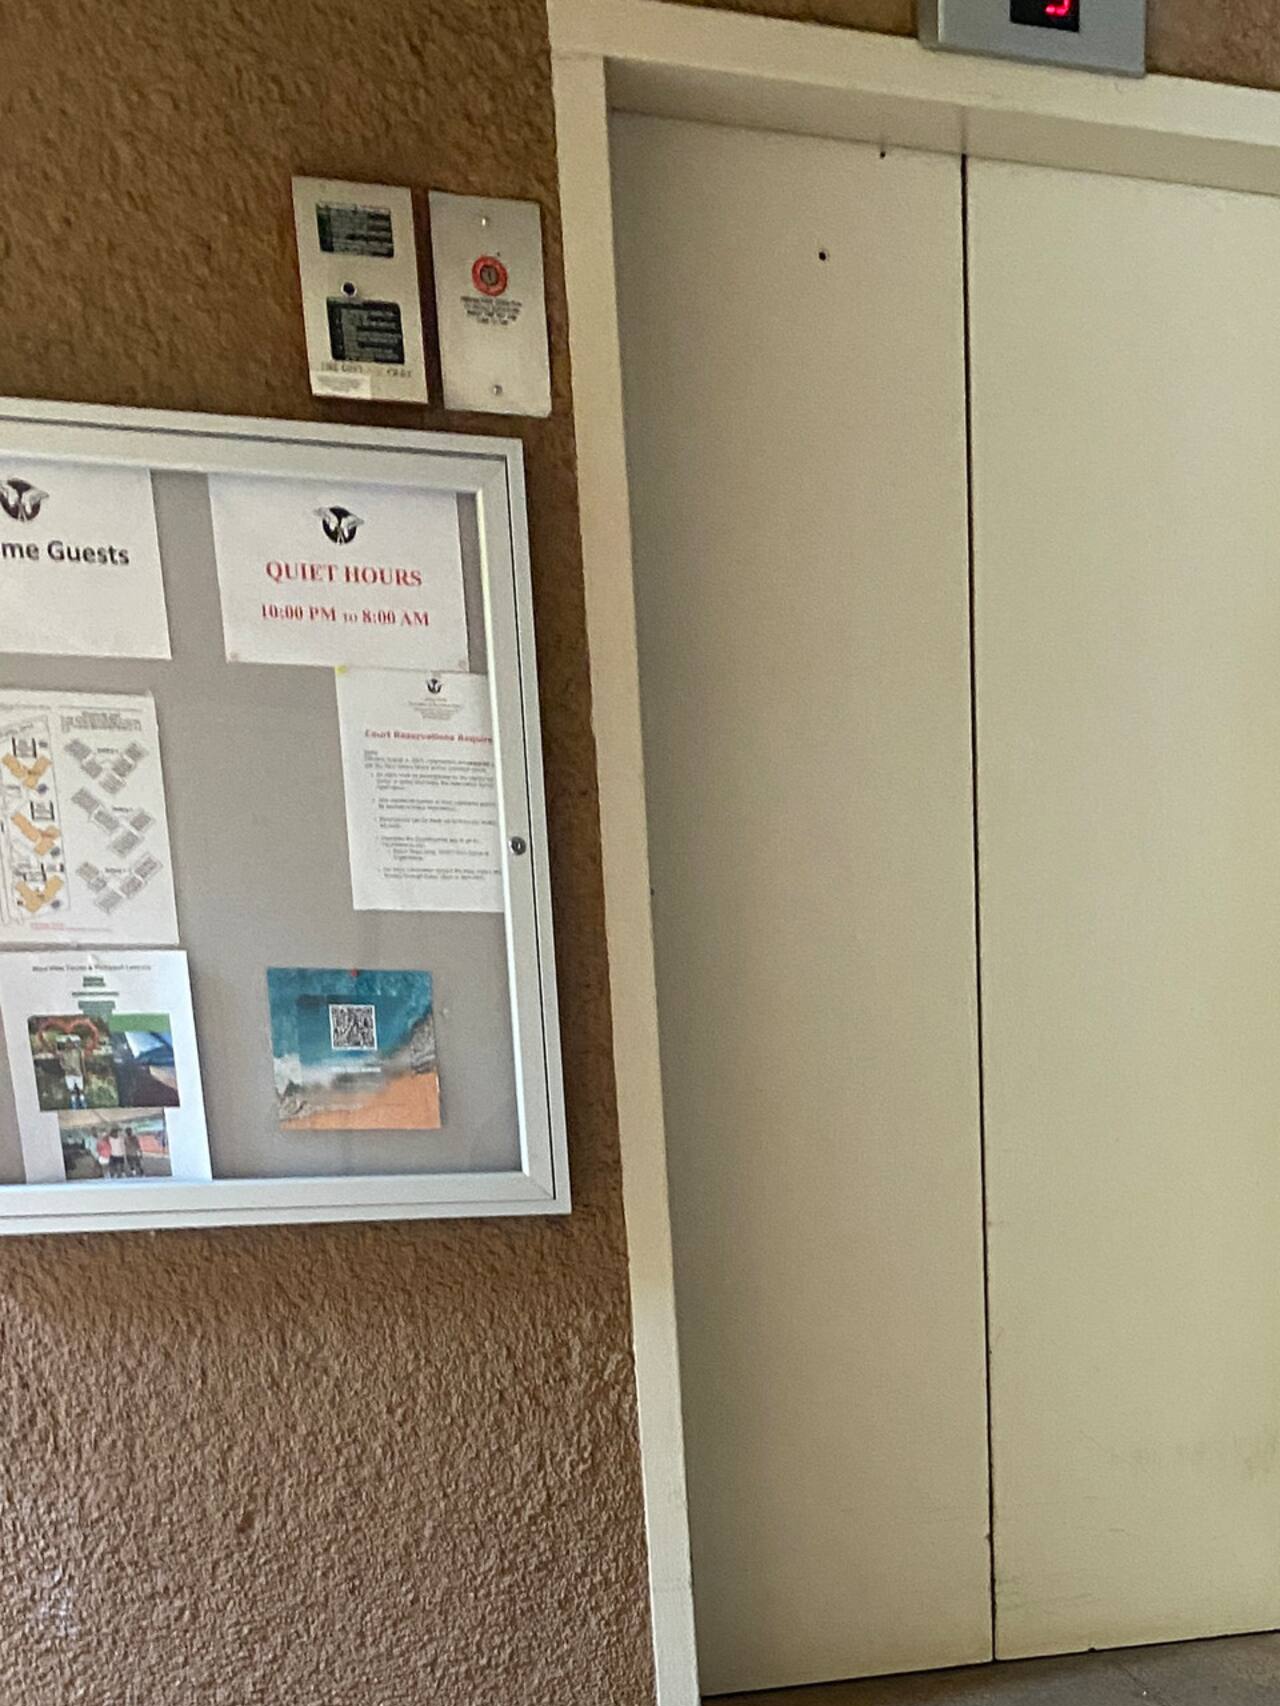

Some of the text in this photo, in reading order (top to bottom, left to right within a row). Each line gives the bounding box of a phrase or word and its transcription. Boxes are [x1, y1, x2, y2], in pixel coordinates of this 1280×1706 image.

[47, 540, 130, 566] Guests
[266, 560, 423, 587] QUIET HOURS
[261, 603, 429, 627] 10:00 PM to 8:00 AM
[457, 733, 493, 745] Require
